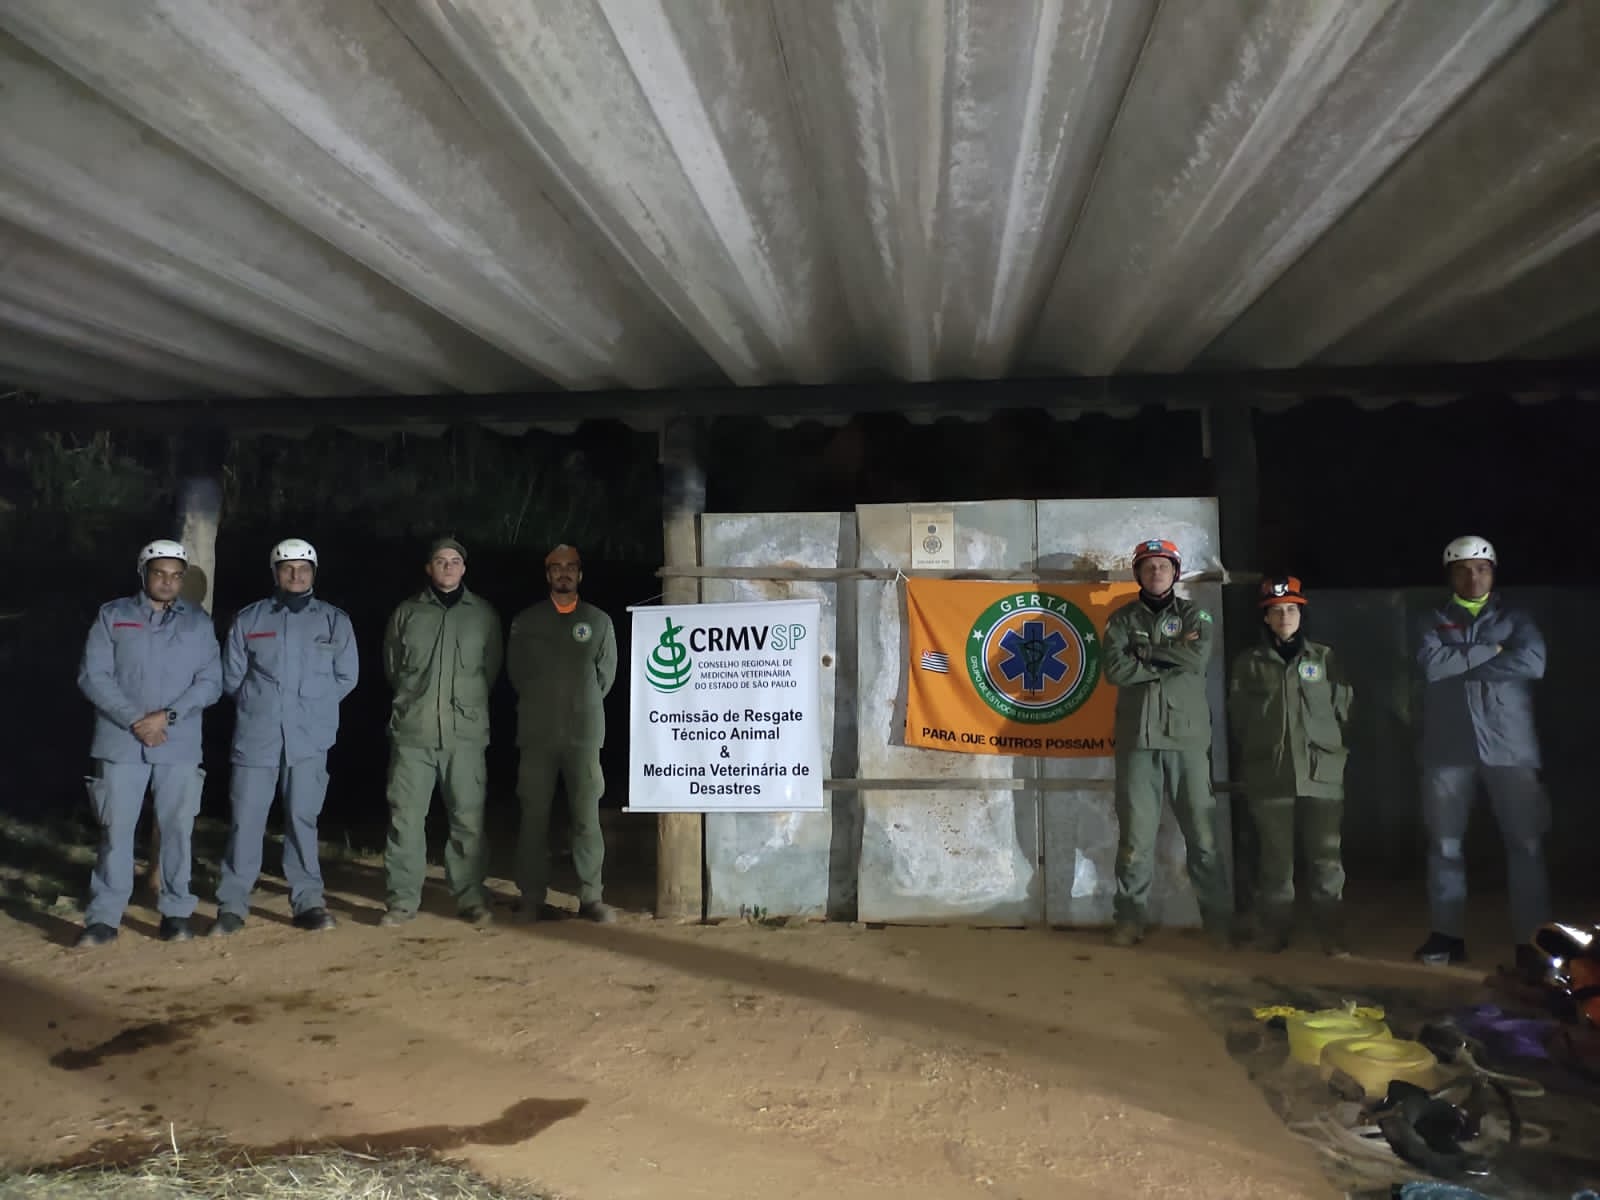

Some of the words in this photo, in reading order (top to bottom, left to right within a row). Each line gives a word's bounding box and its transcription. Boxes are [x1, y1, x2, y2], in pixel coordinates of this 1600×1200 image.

[1000, 594, 1068, 615] GERTA
[698, 660, 739, 669] CONSELHO
[741, 659, 781, 668] REGIONAL
[782, 659, 793, 667] DE
[700, 671, 739, 679] MEDICINA
[741, 669, 791, 678] VETERINÁRIA
[695, 682, 707, 690] DO
[708, 681, 739, 689] ESTADO
[740, 681, 750, 689] DE
[752, 680, 769, 689] SÃO
[771, 680, 797, 688] PAULO
[649, 709, 719, 724] Comissão
[723, 709, 740, 723] de
[744, 708, 803, 725] Resgate
[671, 727, 727, 741] Técnico
[730, 726, 780, 740] Animal
[922, 727, 956, 742] PARA
[960, 732, 986, 745] QUE
[989, 736, 1042, 748] OUTROS
[1046, 738, 1104, 750] POSSAM
[719, 745, 730, 759] &
[643, 763, 706, 777] Medicina
[710, 762, 787, 777] Veterinária
[791, 763, 810, 776] de
[689, 781, 761, 795] Desastres
